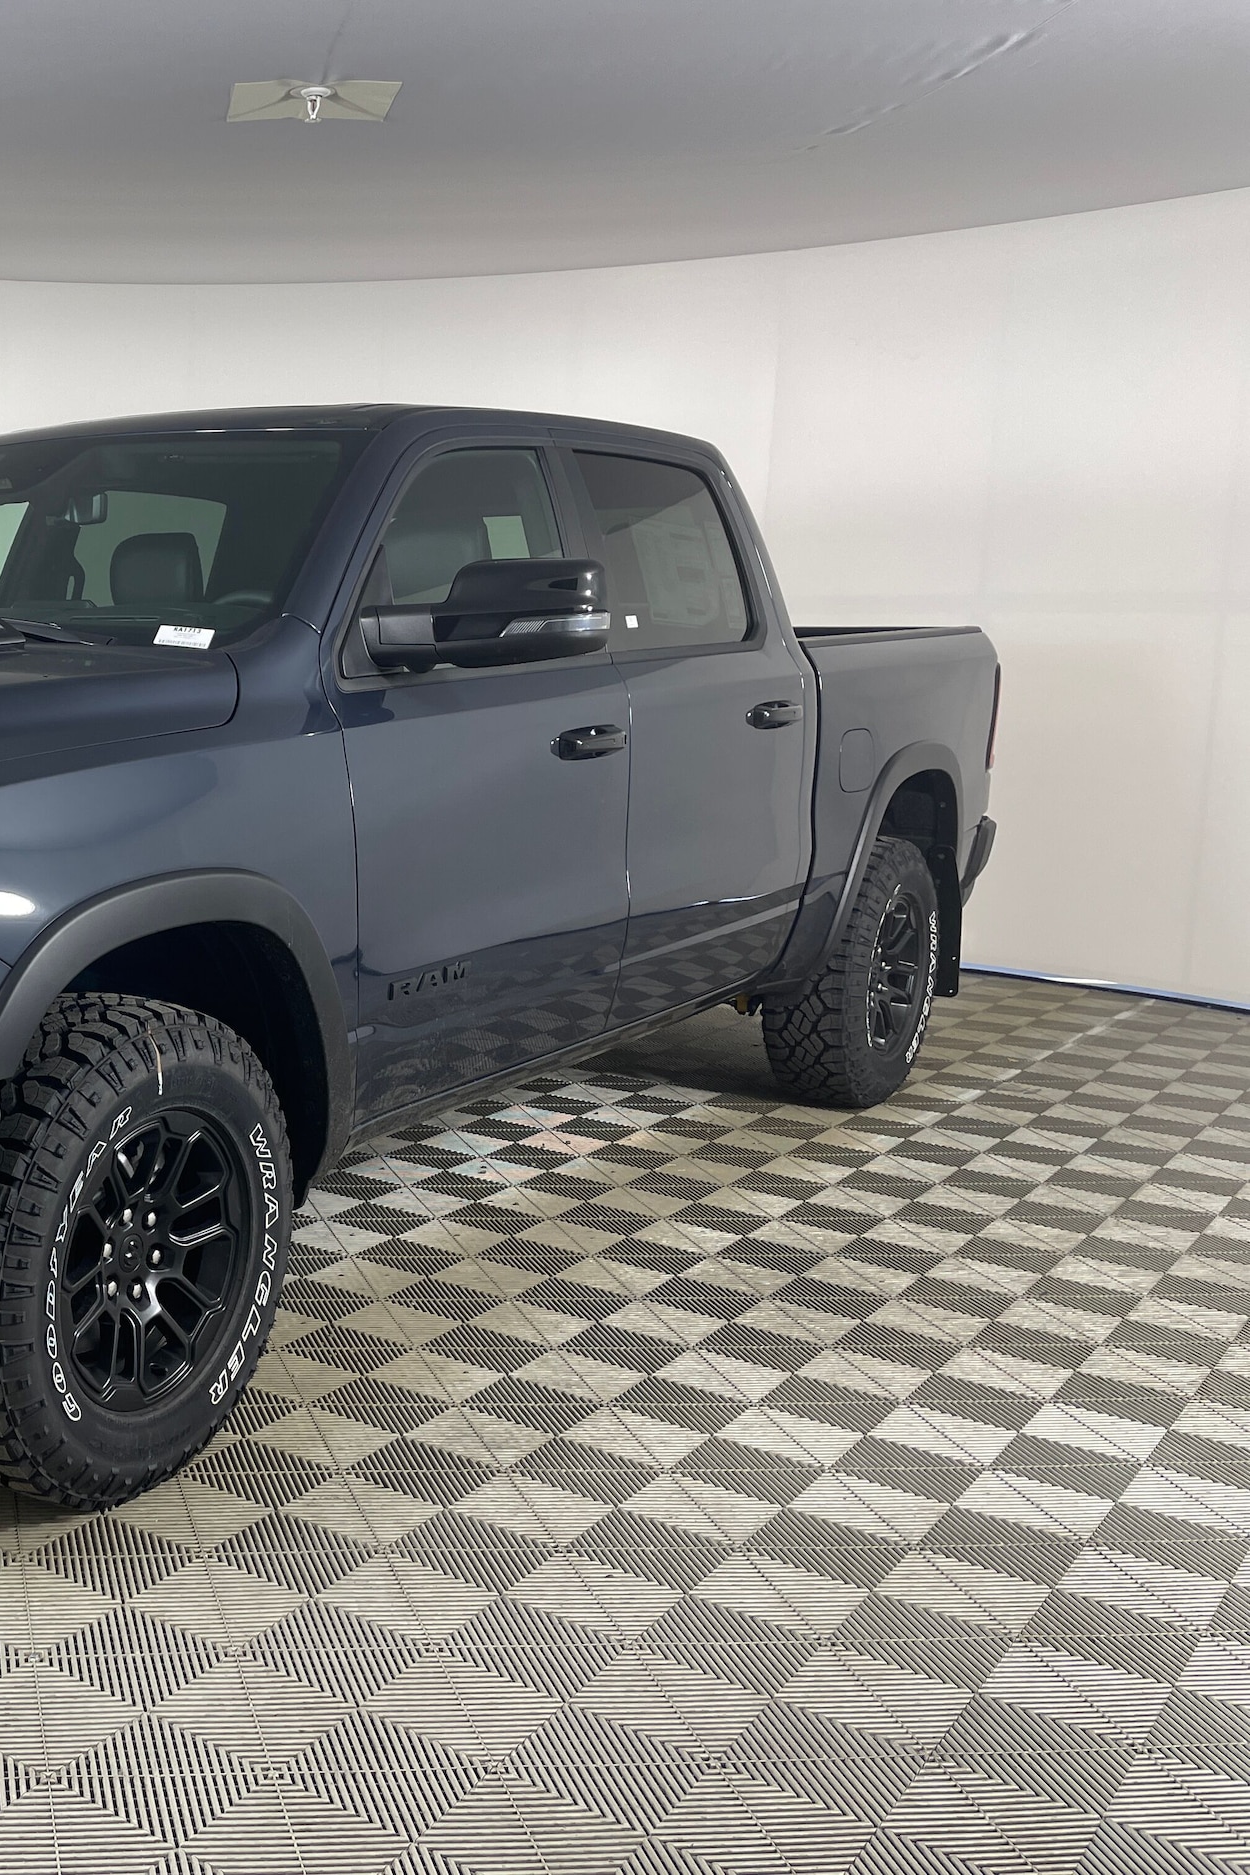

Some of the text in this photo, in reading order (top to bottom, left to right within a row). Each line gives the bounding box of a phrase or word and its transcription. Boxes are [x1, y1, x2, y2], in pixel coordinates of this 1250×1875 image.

[387, 960, 472, 1000] RAM
[45, 1105, 133, 1422] GOODYEAR
[209, 1123, 280, 1405] WRANGLER
